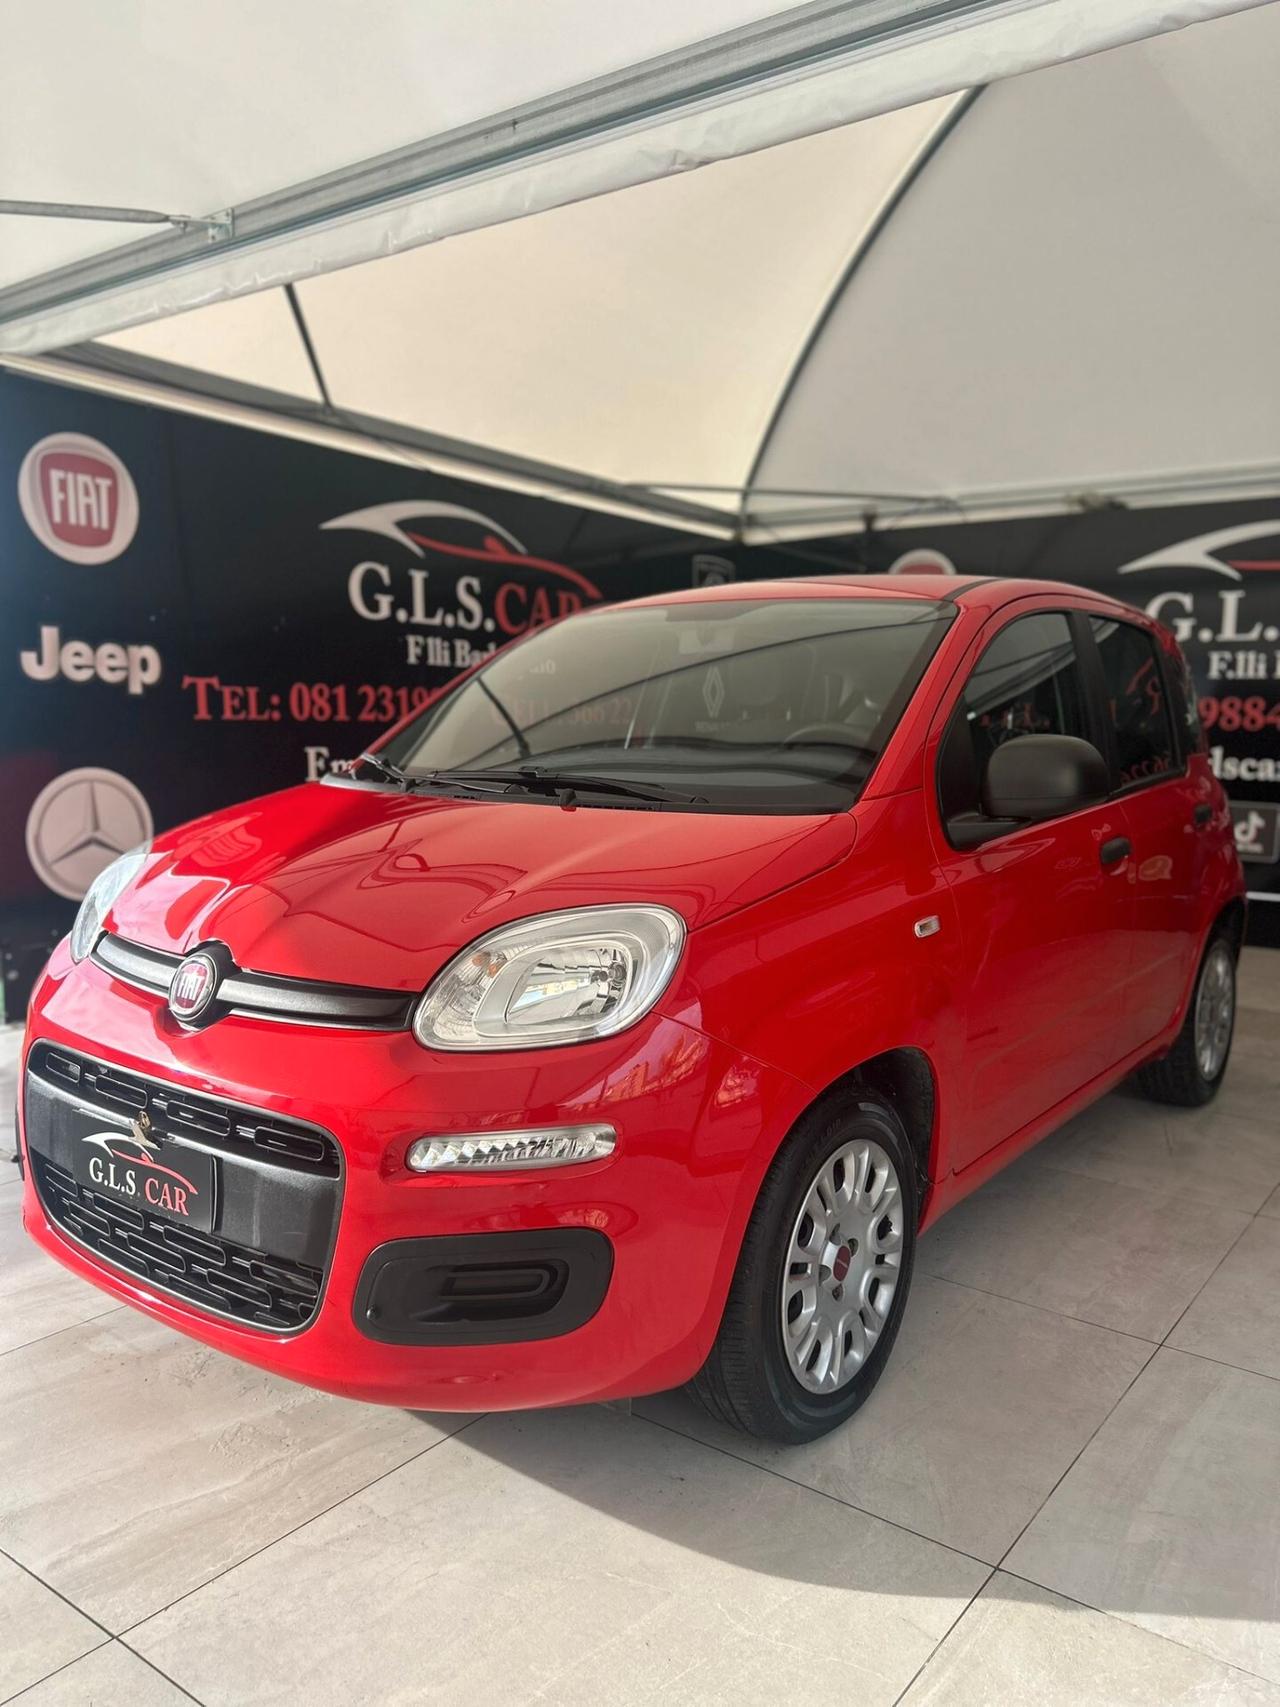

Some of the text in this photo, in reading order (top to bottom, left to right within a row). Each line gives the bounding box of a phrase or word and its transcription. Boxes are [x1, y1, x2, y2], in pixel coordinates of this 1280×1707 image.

[49, 468, 113, 531] FIAT
[20, 625, 162, 695] Jeep
[289, 682, 350, 722] 081
[144, 1177, 189, 1217] CAR
